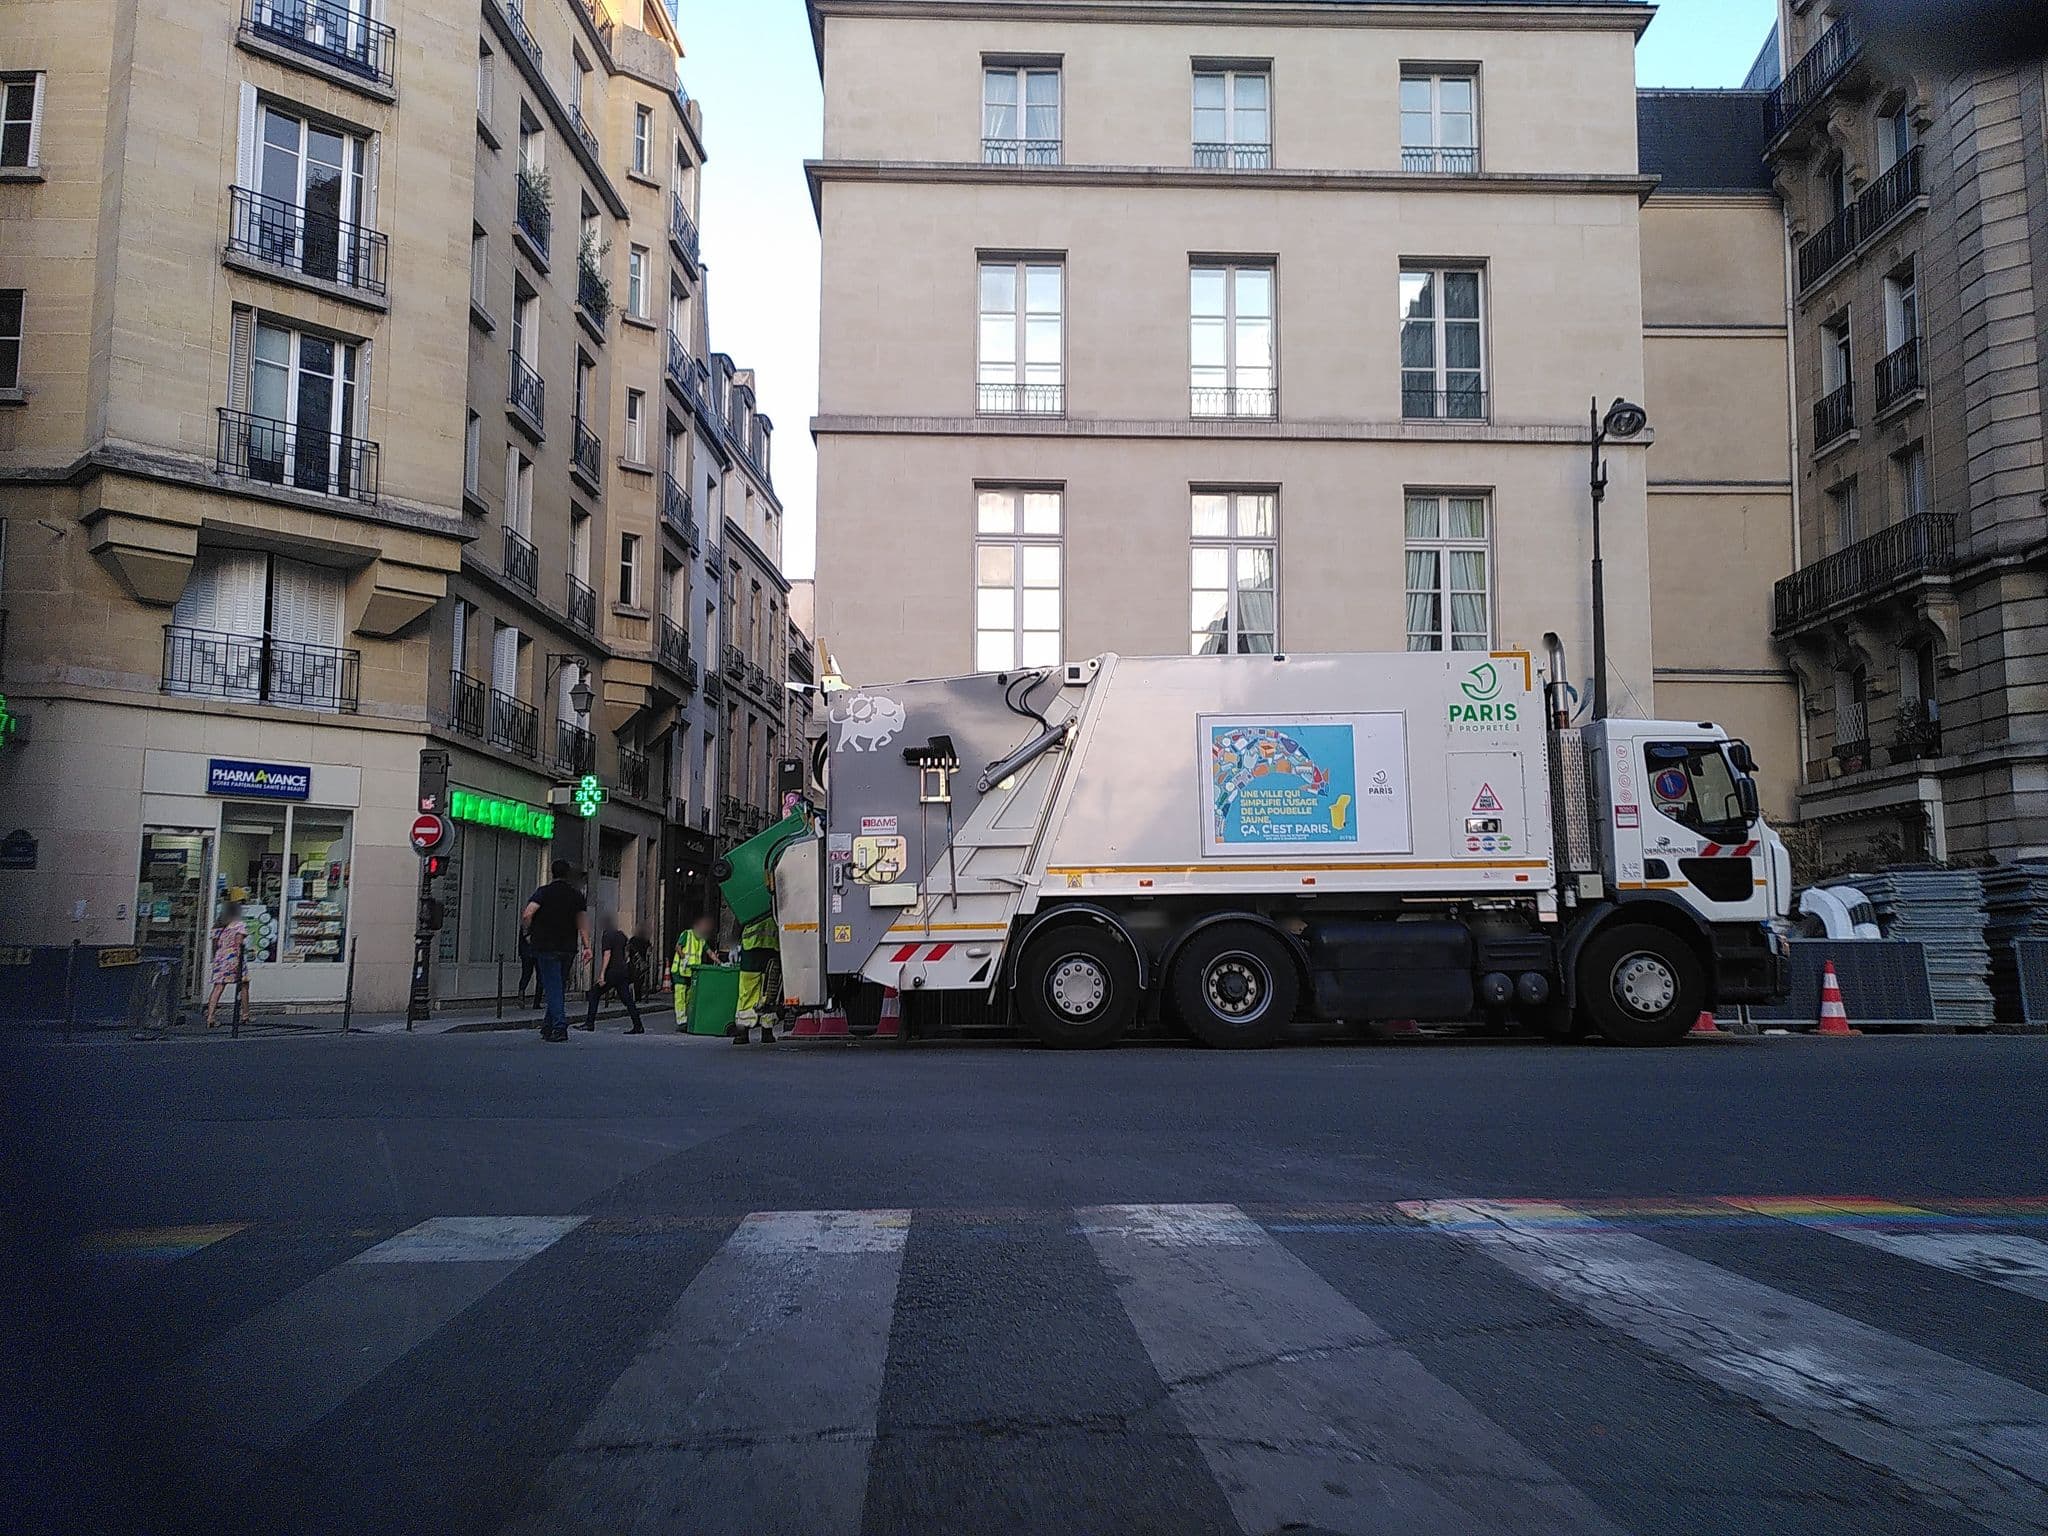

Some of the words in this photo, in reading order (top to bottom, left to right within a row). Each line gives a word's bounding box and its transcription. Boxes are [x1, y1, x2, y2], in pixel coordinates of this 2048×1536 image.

[1448, 703, 1517, 721] PARIS
[1459, 723, 1510, 732] PROPRETÉ
[212, 769, 307, 787] PHARMAVANCE
[1240, 790, 1258, 798] UNE
[1259, 790, 1283, 798] VILLE
[1284, 790, 1301, 798] QUI
[1368, 787, 1393, 795] PARIS
[575, 790, 602, 802] 31°C
[1240, 799, 1281, 807] SIMPLIFIE
[1282, 799, 1318, 807] L'USAGE
[1240, 807, 1253, 815] DE
[1254, 807, 1266, 815] LA
[1267, 807, 1312, 815] POUBELLE
[1240, 824, 1260, 837] ÇA,
[1262, 824, 1293, 834] C'EST
[1295, 824, 1332, 834] PARIS.
